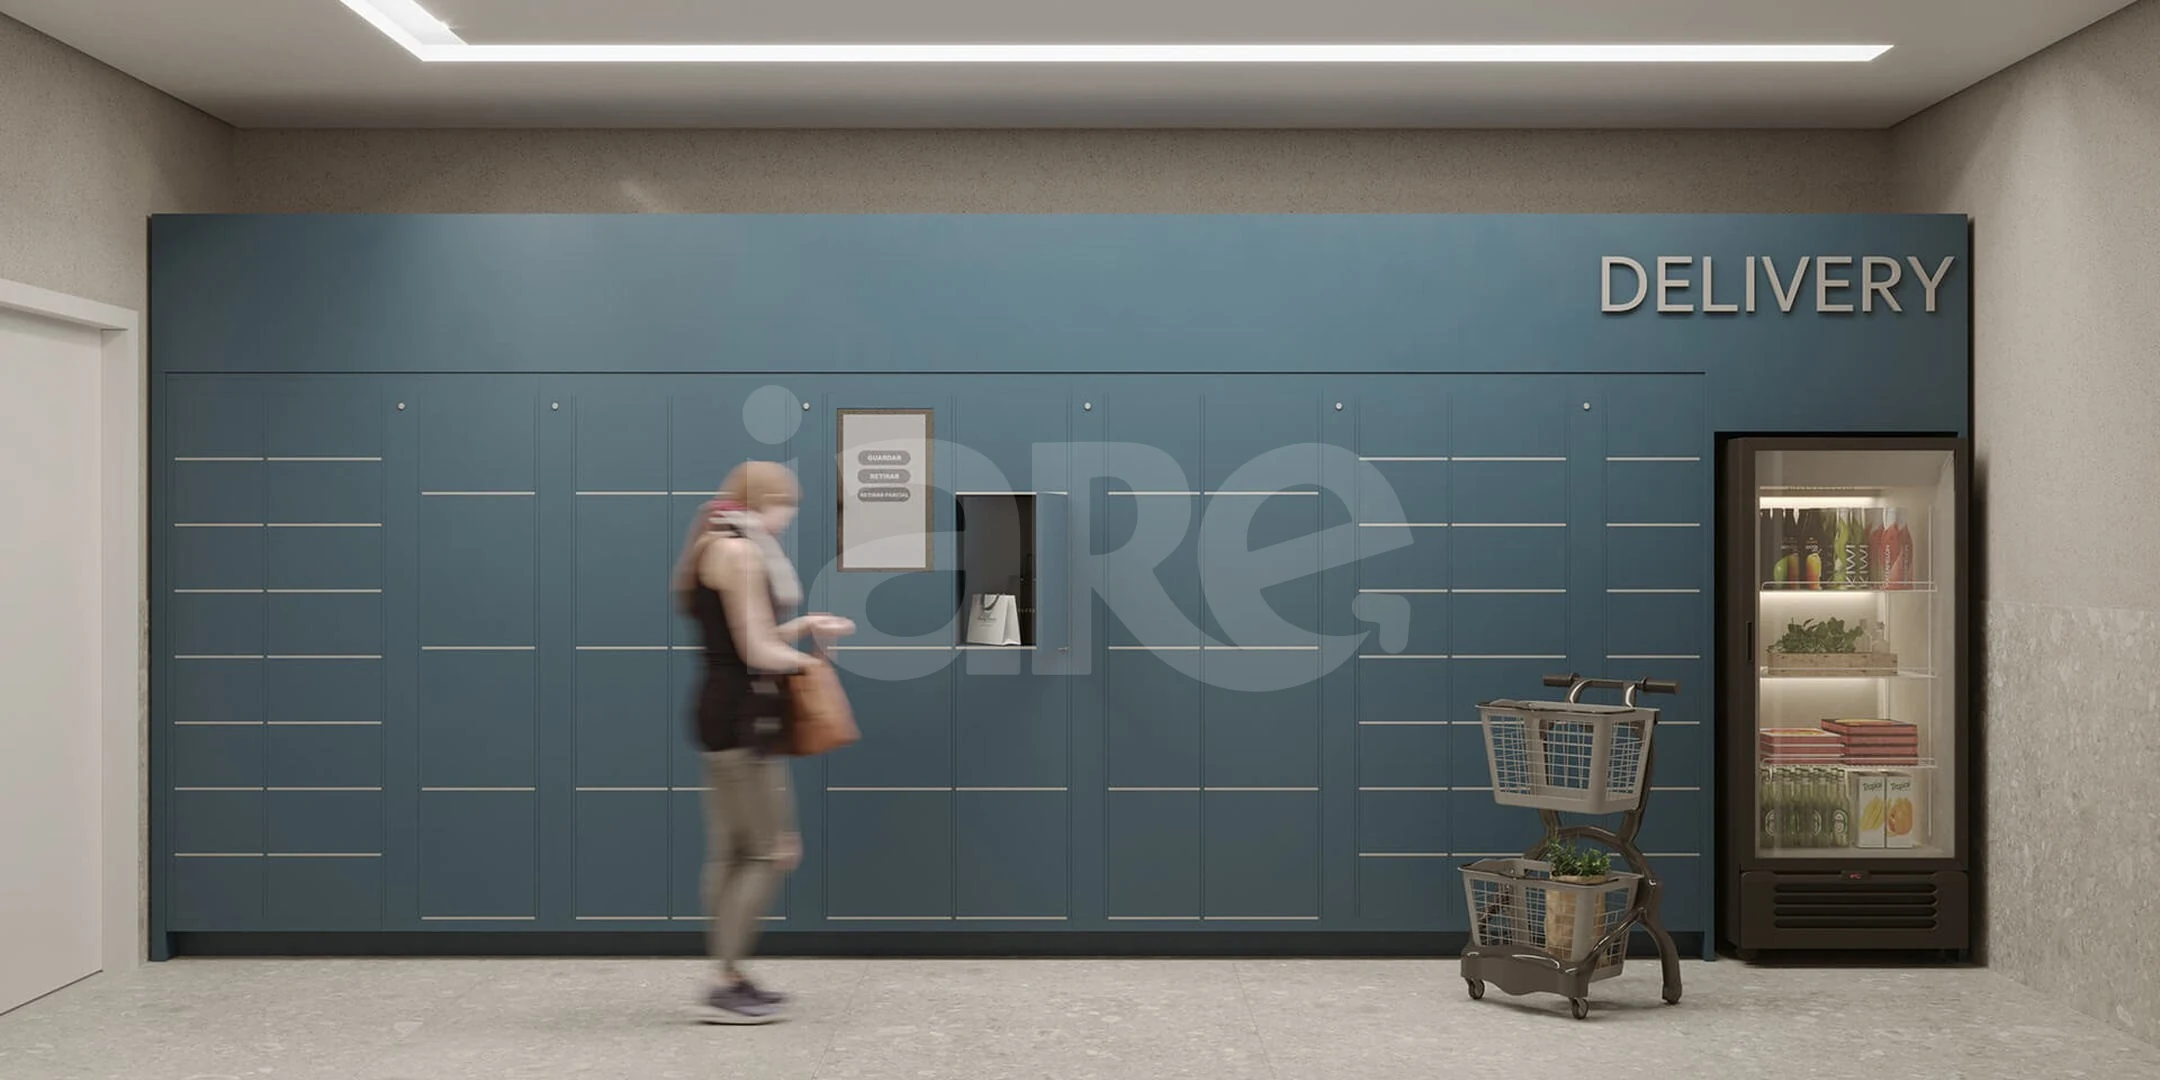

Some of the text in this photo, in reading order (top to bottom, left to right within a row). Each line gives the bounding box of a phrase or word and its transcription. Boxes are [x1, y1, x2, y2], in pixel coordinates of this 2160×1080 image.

[1601, 255, 1956, 313] DELIVERY
[869, 472, 900, 480] RETIRAR
[1845, 544, 1856, 588] KIWI
[1859, 544, 1869, 588] KIWI
